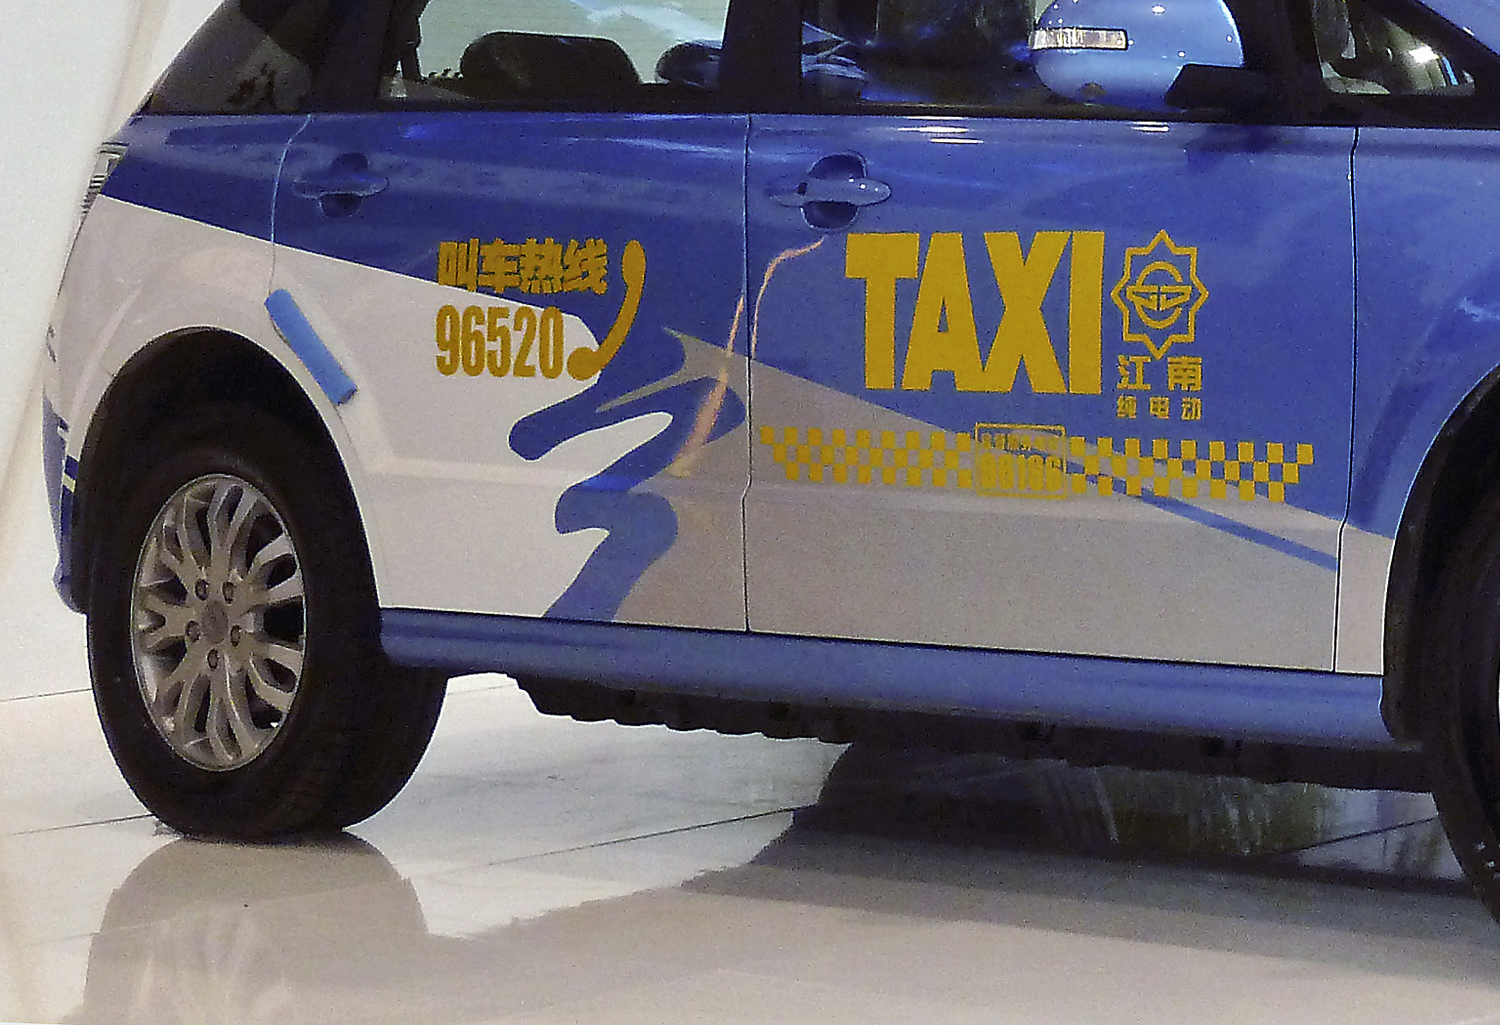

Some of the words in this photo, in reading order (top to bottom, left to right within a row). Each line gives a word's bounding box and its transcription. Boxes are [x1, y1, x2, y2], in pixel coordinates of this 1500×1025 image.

[437, 238, 608, 295] 叫车热线
[435, 304, 565, 380] 96520
[845, 230, 1105, 394] TAXI
[1116, 354, 1203, 392] 江南
